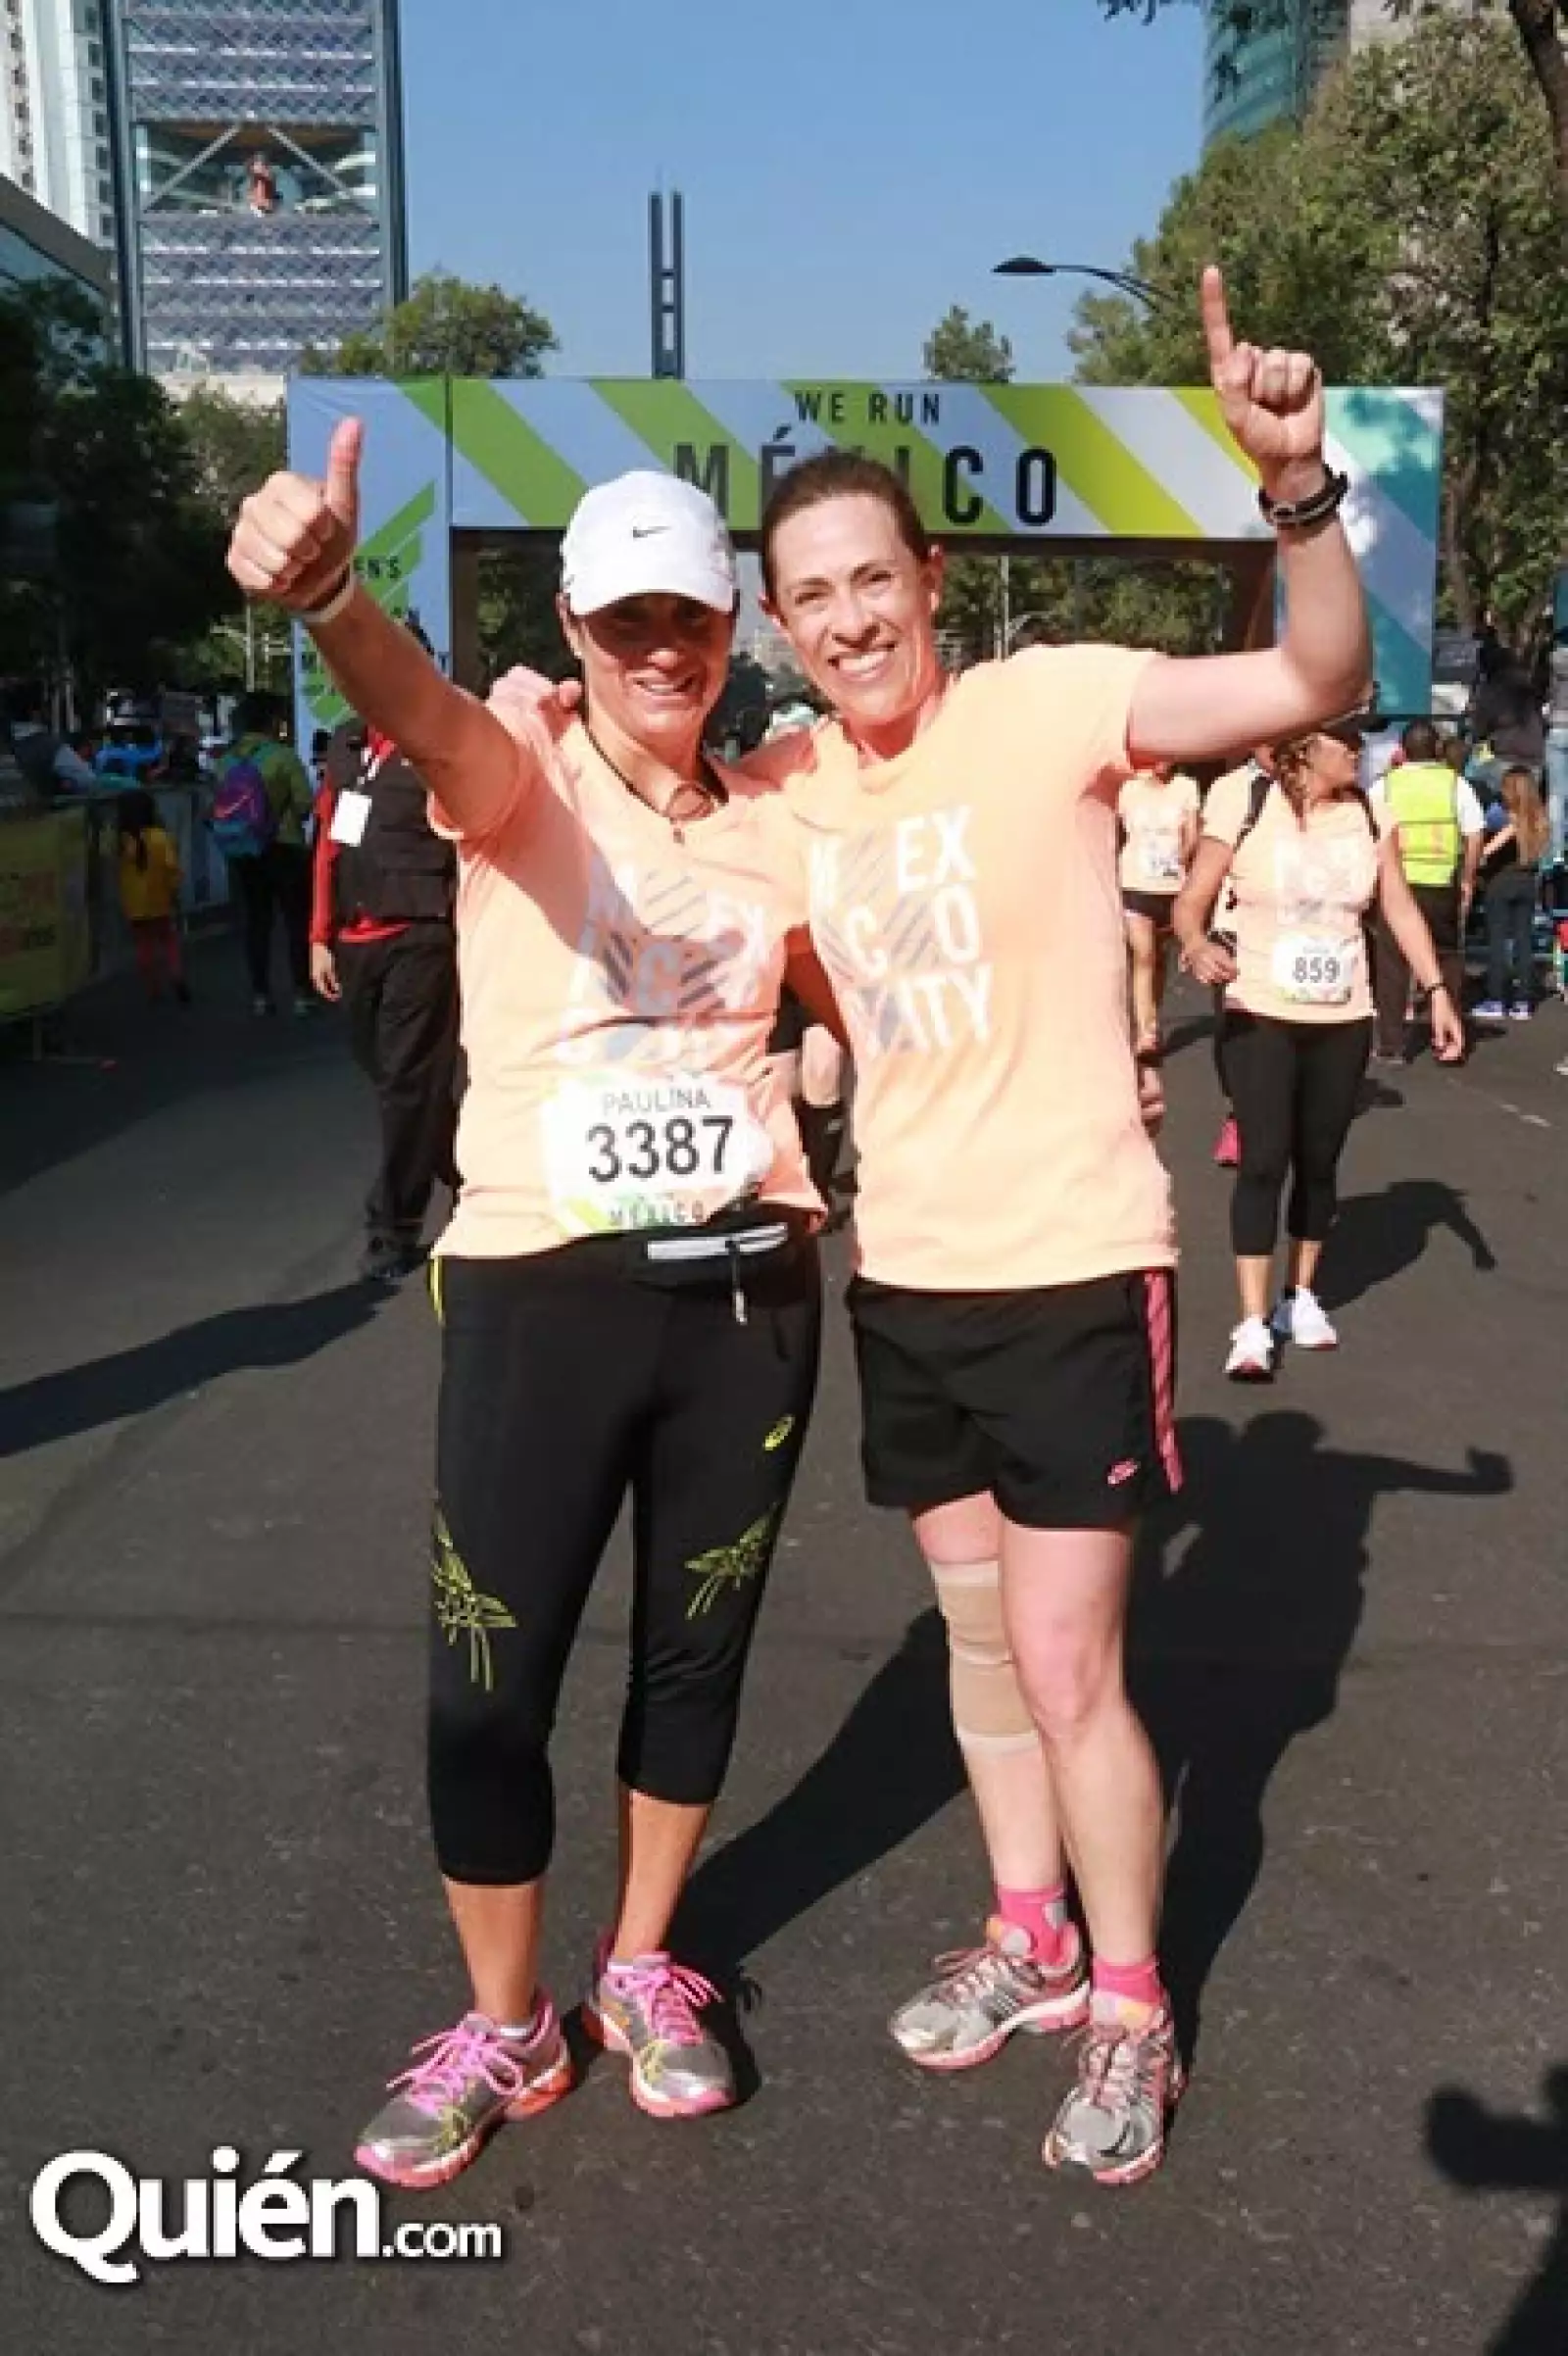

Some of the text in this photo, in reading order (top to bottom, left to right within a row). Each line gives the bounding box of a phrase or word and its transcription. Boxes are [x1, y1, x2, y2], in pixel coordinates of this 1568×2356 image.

[795, 391, 940, 424] WE RUN
[1291, 956, 1341, 984] 859
[601, 1086, 711, 1115] PAULINA
[585, 1114, 734, 1183] 3387
